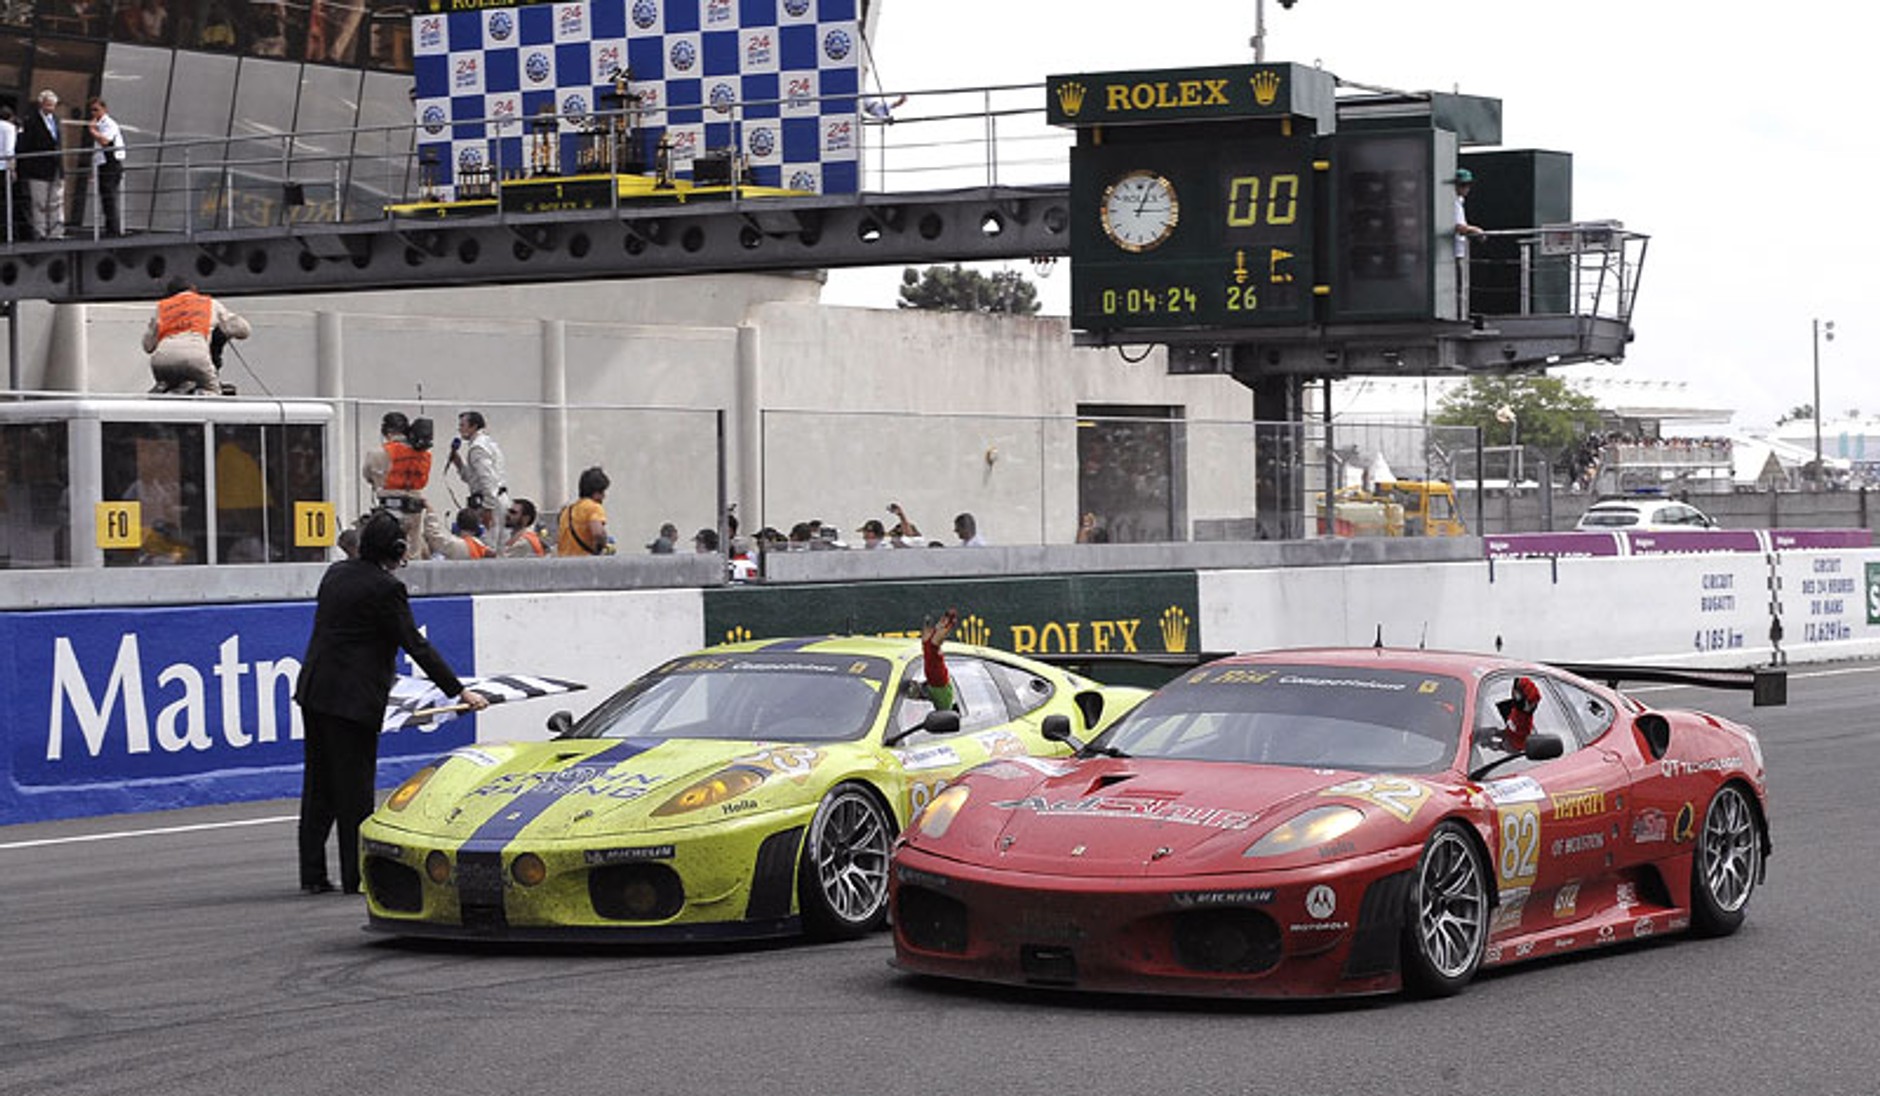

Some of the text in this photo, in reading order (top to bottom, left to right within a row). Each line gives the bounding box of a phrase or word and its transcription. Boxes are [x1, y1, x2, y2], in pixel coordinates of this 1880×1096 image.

[561, 5, 582, 21] 24
[421, 19, 440, 33] 24
[748, 35, 770, 51] 24
[599, 47, 618, 62] 24
[456, 59, 476, 74] 24
[788, 78, 810, 95] 24
[1106, 79, 1230, 111] ROLEX
[494, 100, 514, 113] 24
[828, 122, 850, 138] 24
[674, 132, 695, 147] 24
[1227, 175, 1299, 228] 00
[1103, 286, 1257, 314] 0:04:24 26
[1010, 619, 1140, 653] ROLEX
[721, 800, 758, 815] Hella
[1551, 787, 1606, 820] Ferrari
[1501, 810, 1538, 880] 82
[1197, 892, 1273, 903] MICHELIN
